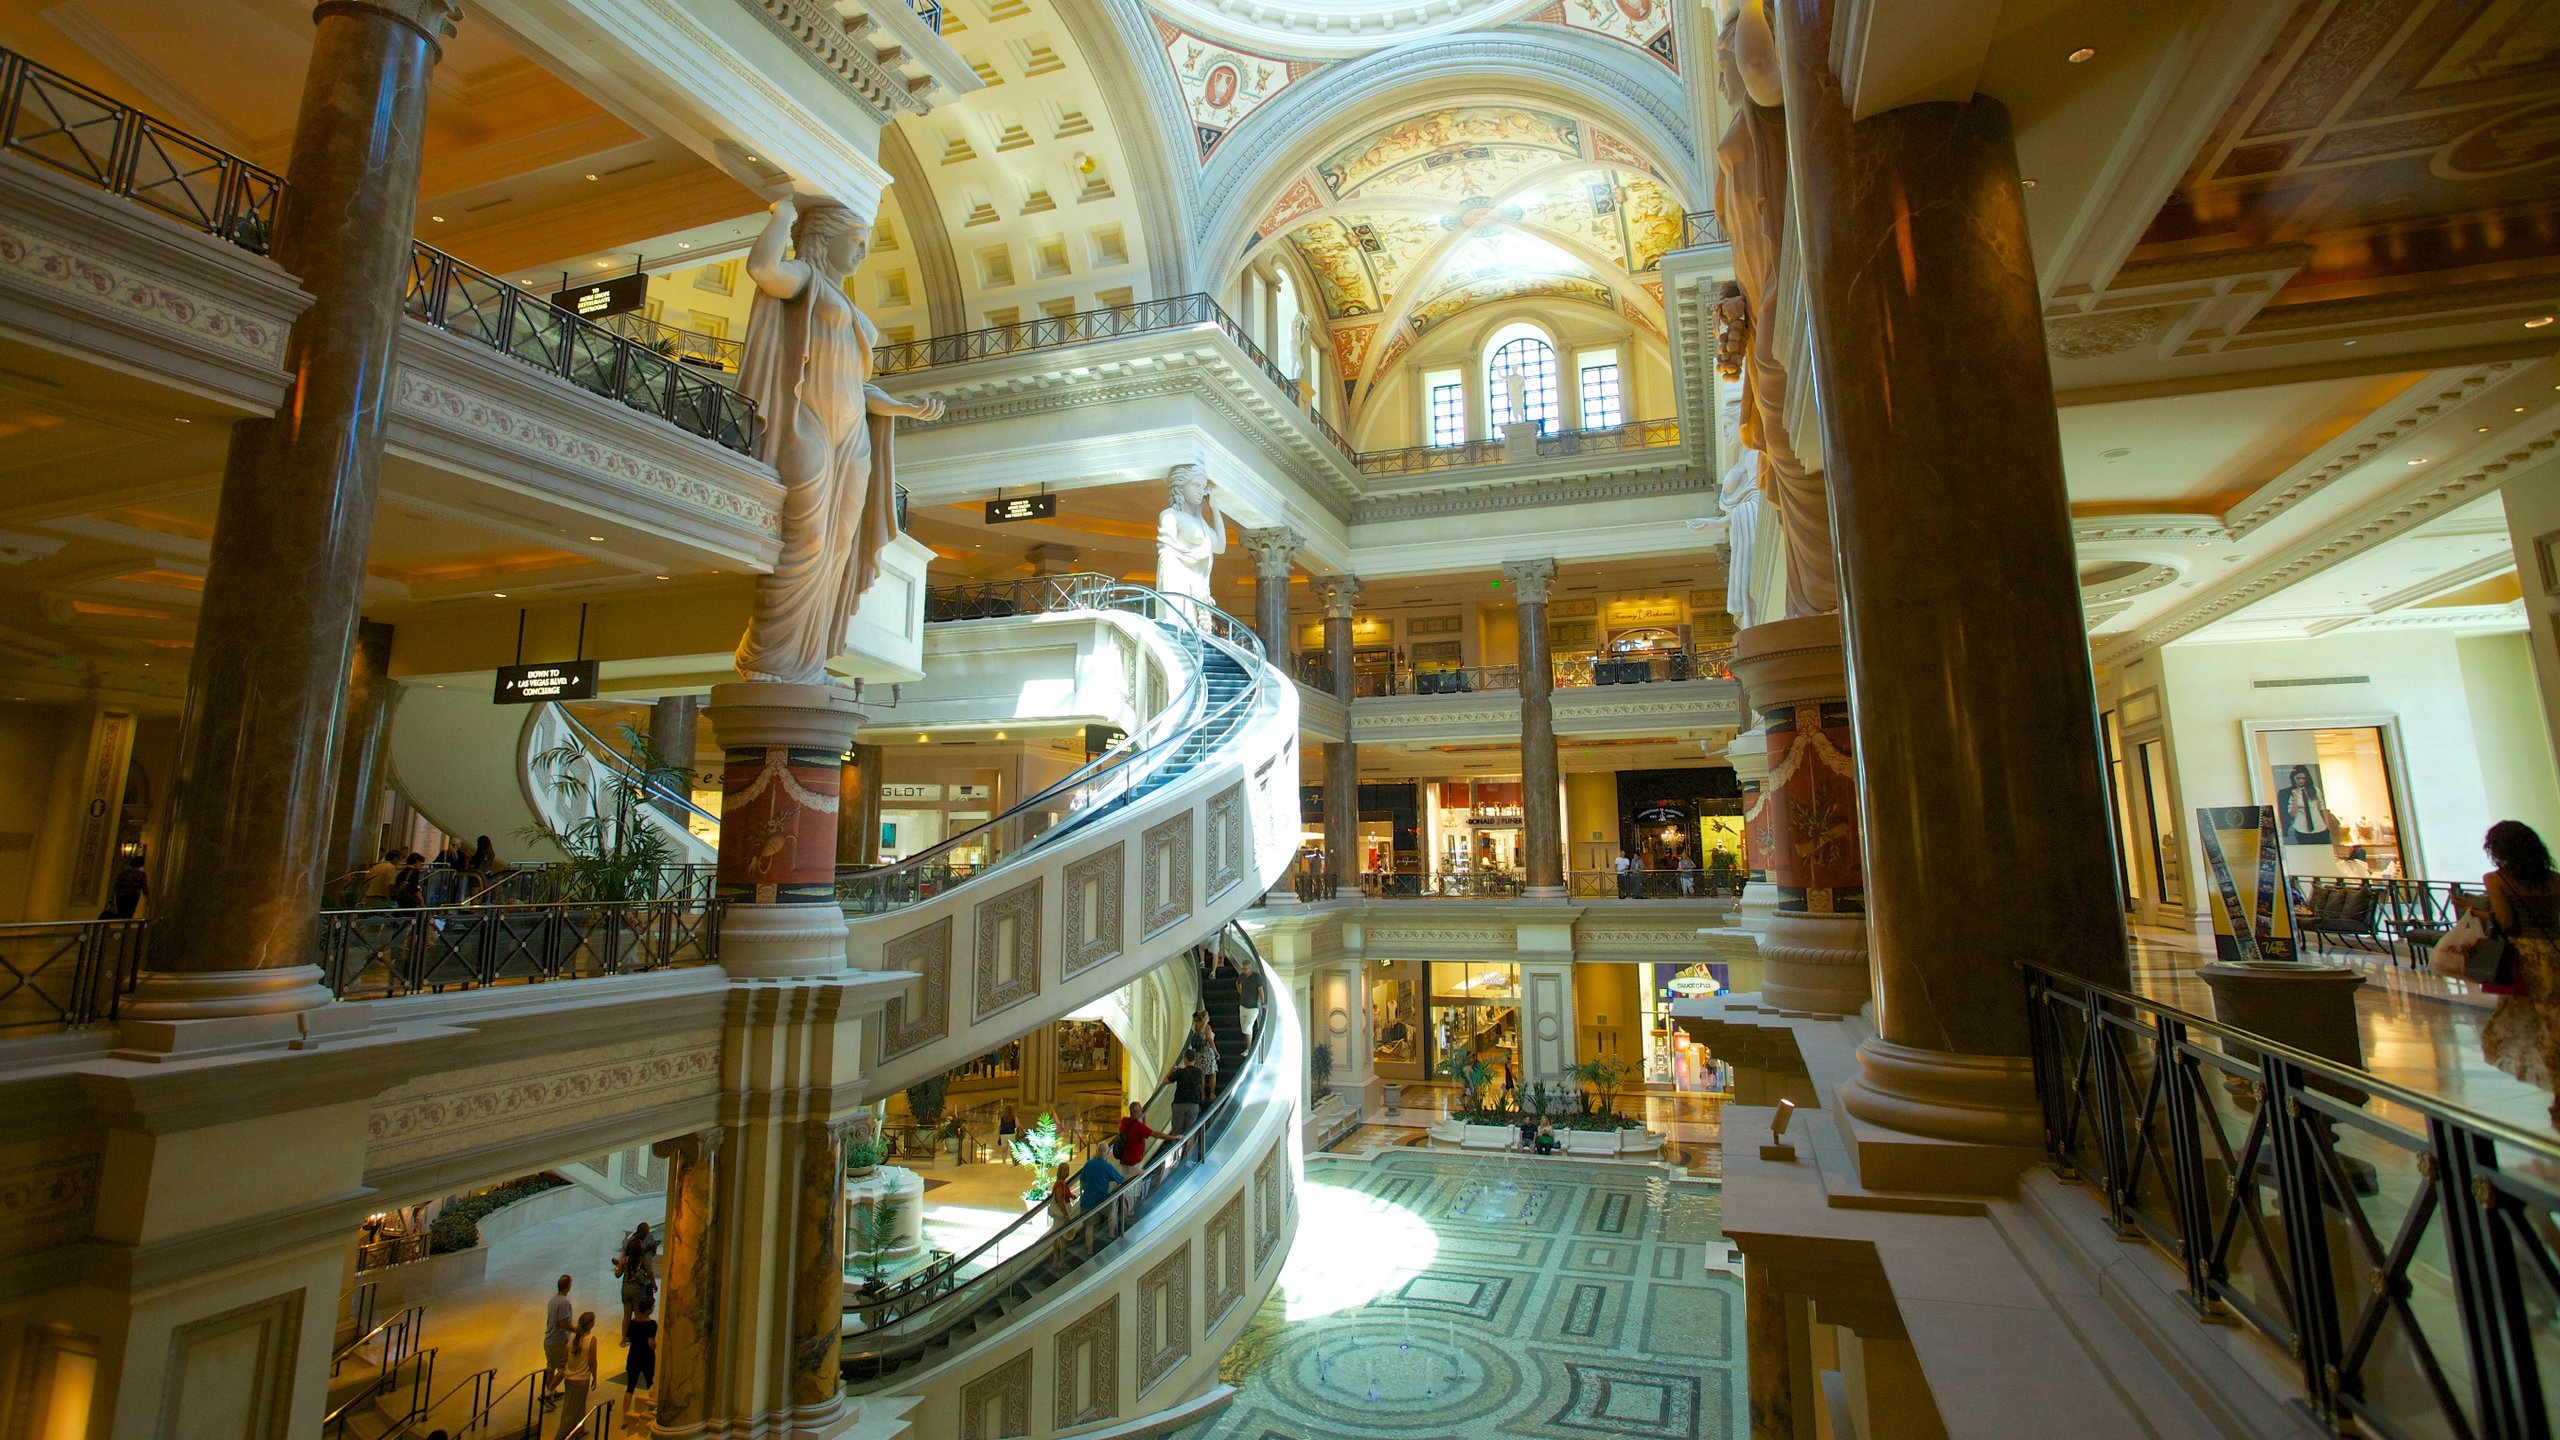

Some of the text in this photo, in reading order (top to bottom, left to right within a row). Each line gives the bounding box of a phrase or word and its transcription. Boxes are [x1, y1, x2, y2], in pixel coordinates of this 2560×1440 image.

[527, 669, 560, 679] DOWN TO
[517, 680, 529, 688] LAS
[530, 678, 549, 687] VEGAS
[522, 686, 561, 696] CONCIERGE
